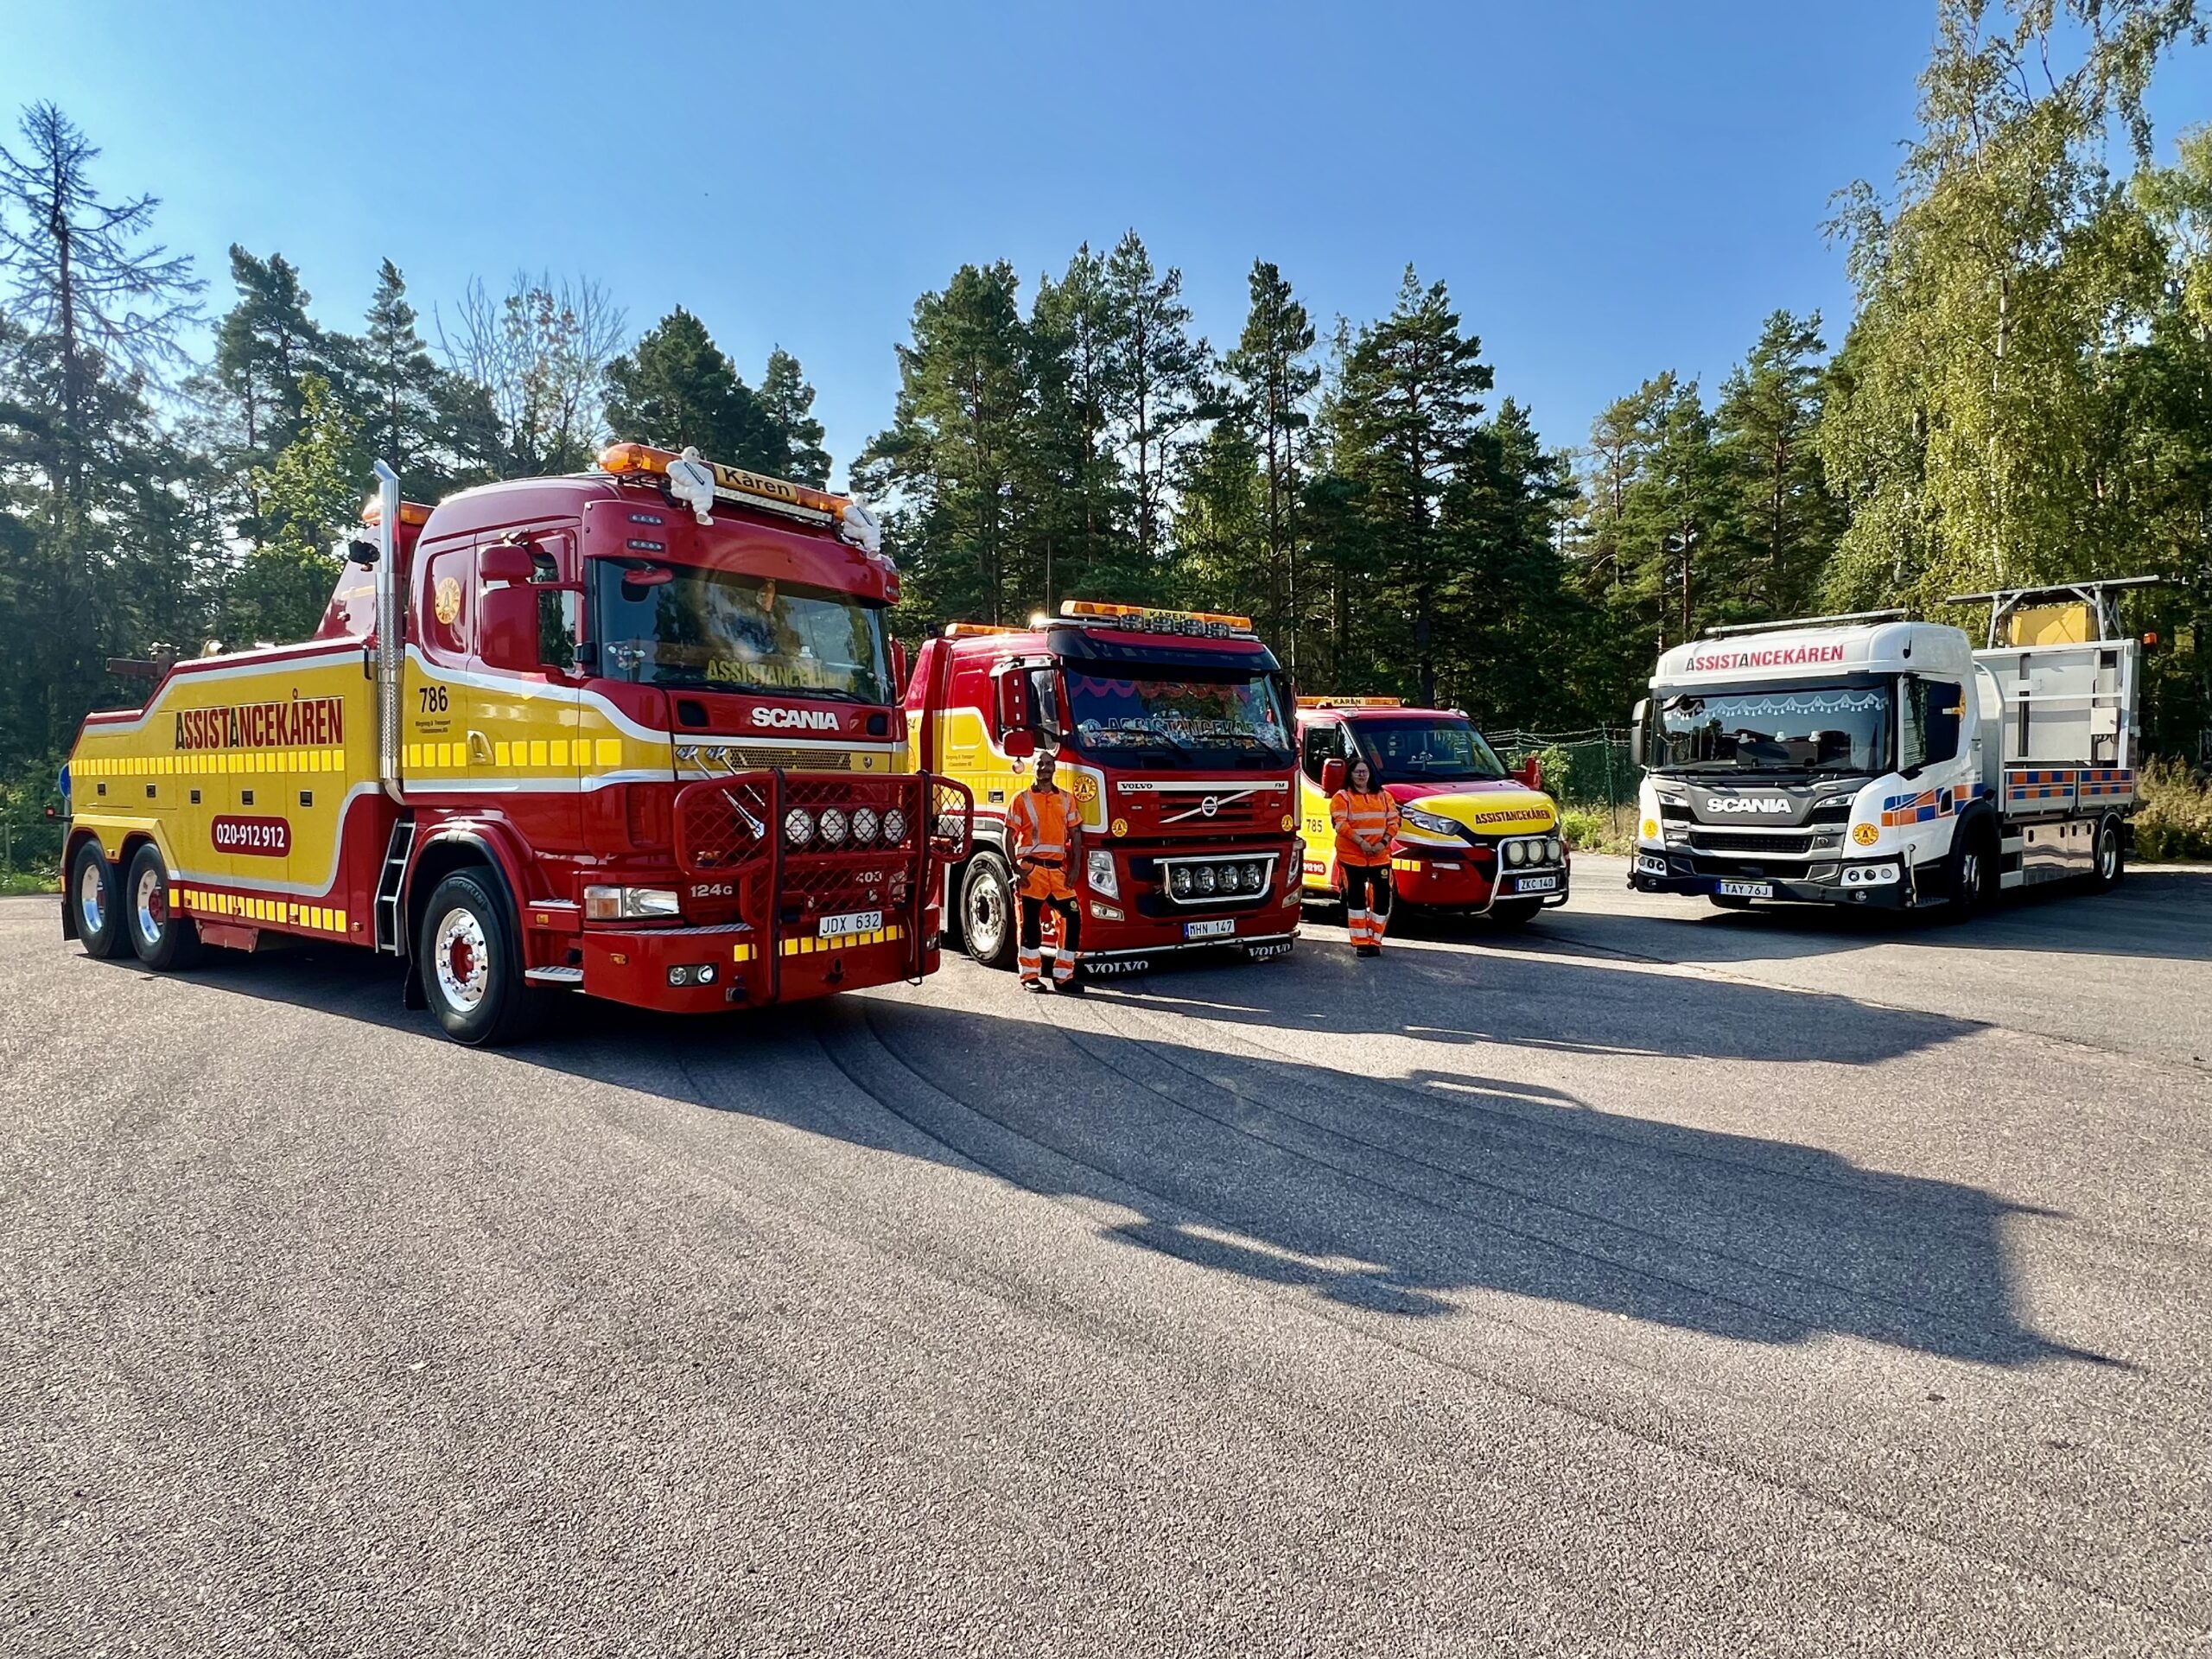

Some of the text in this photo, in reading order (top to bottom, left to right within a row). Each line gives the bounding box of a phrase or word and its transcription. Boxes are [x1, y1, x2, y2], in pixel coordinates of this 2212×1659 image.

[722, 467, 791, 498] Kåren
[1686, 645, 1844, 671] ASSISTANCEKÅREN
[419, 685, 448, 713] 786
[175, 688, 344, 750] ASSISTANCEKÅREN
[751, 706, 840, 731] SCANIA
[1707, 798, 1793, 814] SCANIA
[1475, 808, 1551, 825] ASSISTANCEKÅREN
[1306, 818, 1323, 833] 785
[216, 823, 285, 849] 020-912 912
[690, 883, 734, 898] 124G
[1522, 878, 1554, 890] ZKC 140
[1725, 884, 1768, 895] TAY 76J
[822, 913, 880, 934] JDX 632
[1190, 921, 1233, 936] MHN 147
[1249, 943, 1291, 957] VOLVO
[1084, 960, 1149, 974] VOLVO
